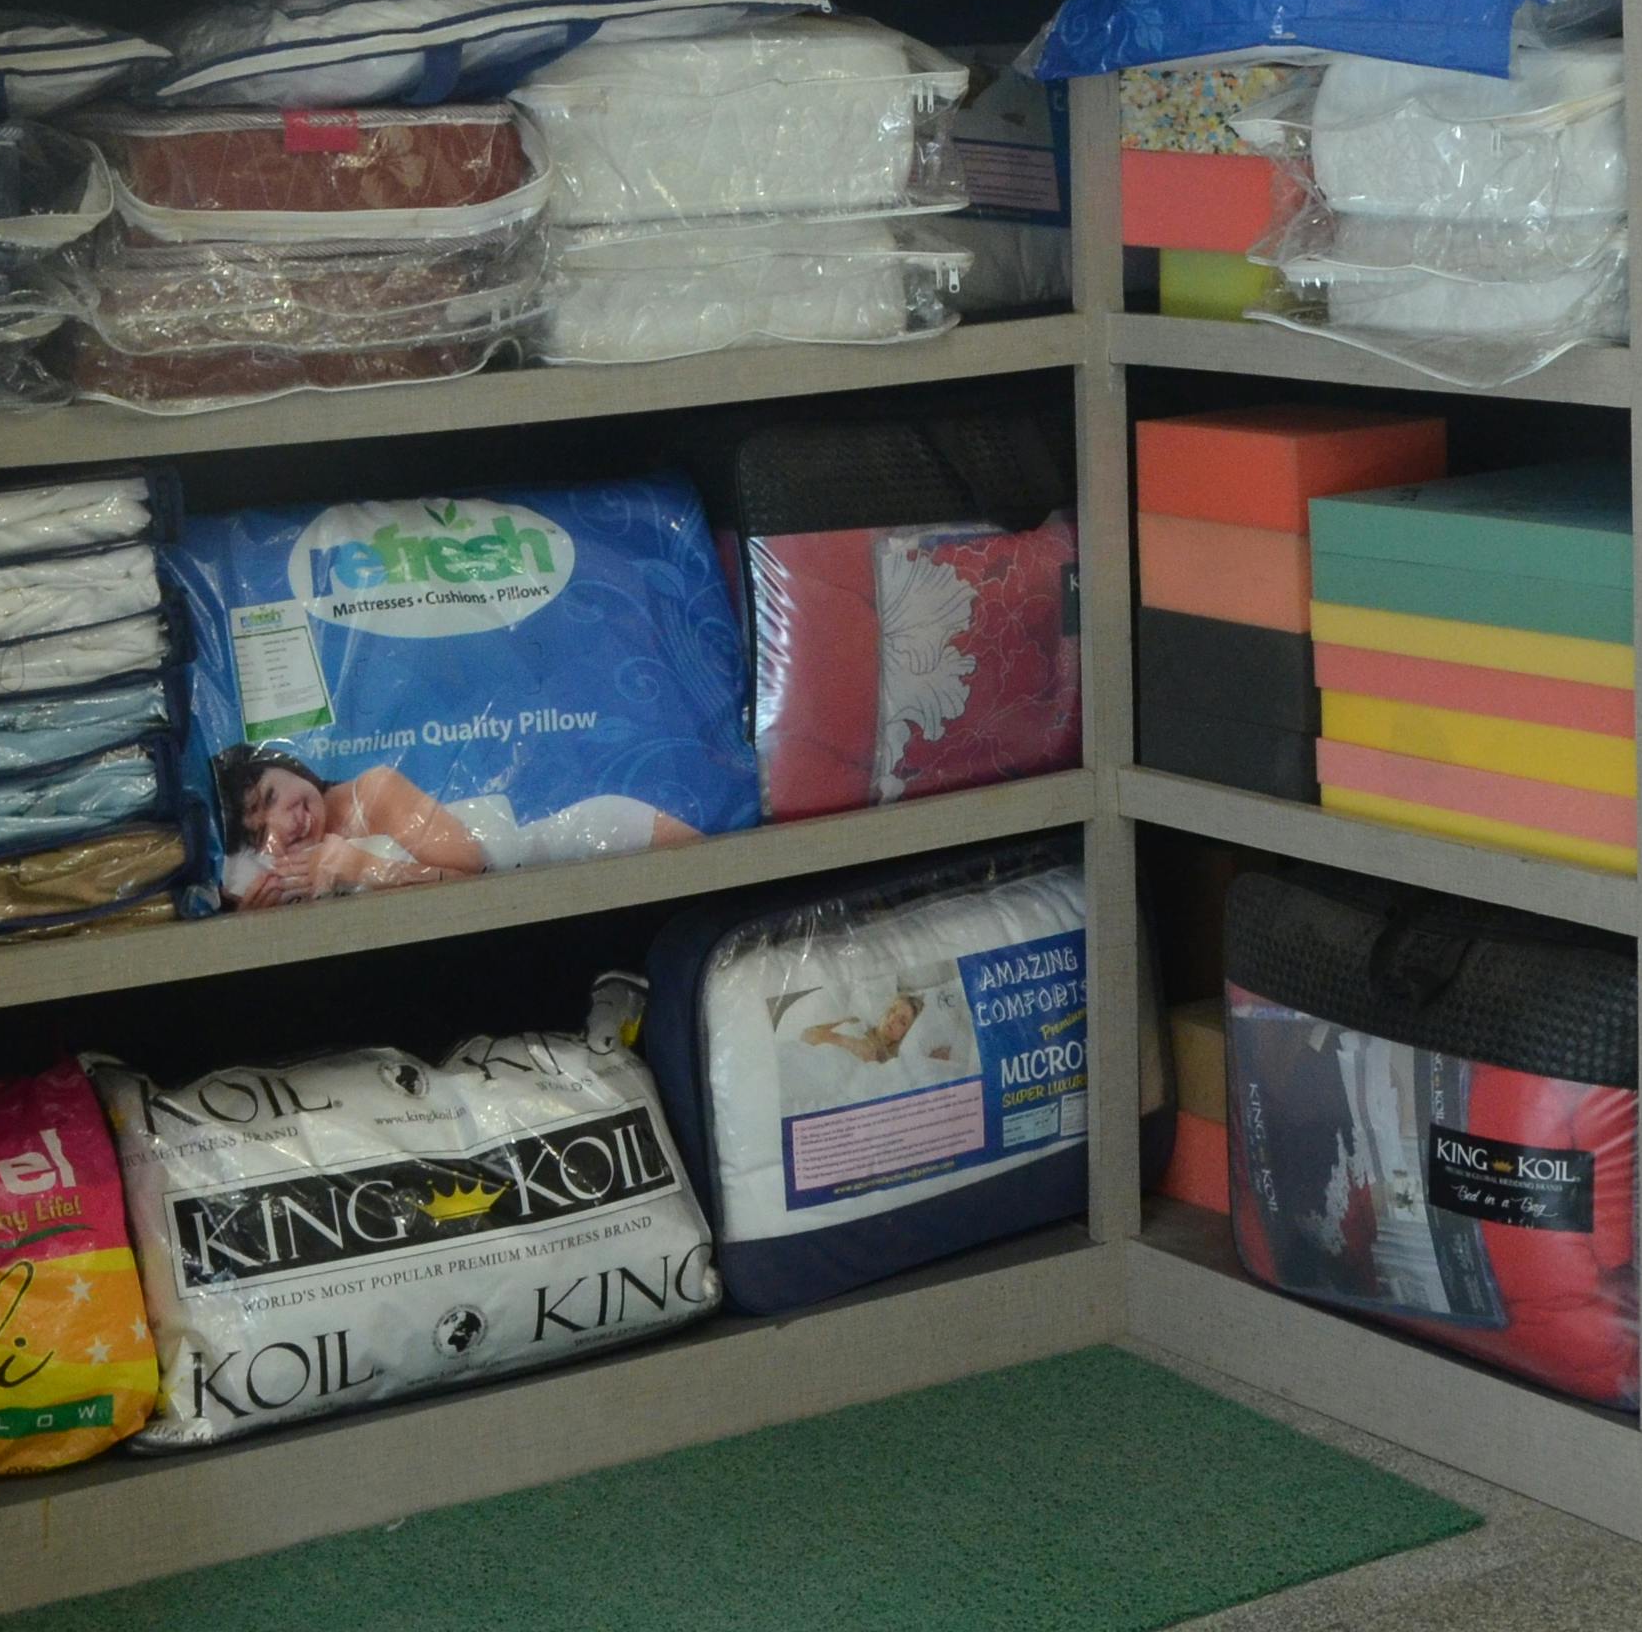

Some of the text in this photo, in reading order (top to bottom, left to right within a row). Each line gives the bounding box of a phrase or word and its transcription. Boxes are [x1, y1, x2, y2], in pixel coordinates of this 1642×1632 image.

[310, 516, 555, 598] refresh
[333, 586, 550, 617] Mattresses Cushions Pillows
[312, 709, 597, 760] Premium Quality Pillow
[980, 947, 1077, 991] AMAZING
[139, 1075, 332, 1136] KOIL
[1003, 1084, 1045, 1108] SUPER
[242, 1127, 299, 1143] BRAND
[1437, 1138, 1575, 1182] KING KOIL
[35, 1195, 82, 1222] Life!
[191, 1124, 668, 1275] KING KOIL
[1452, 1184, 1558, 1217] Bed in a Bag
[243, 1216, 652, 1313] WORLD'S MOST POPULAR PREMIUM MATTRESS BRAND
[190, 1329, 375, 1418] KOIL
